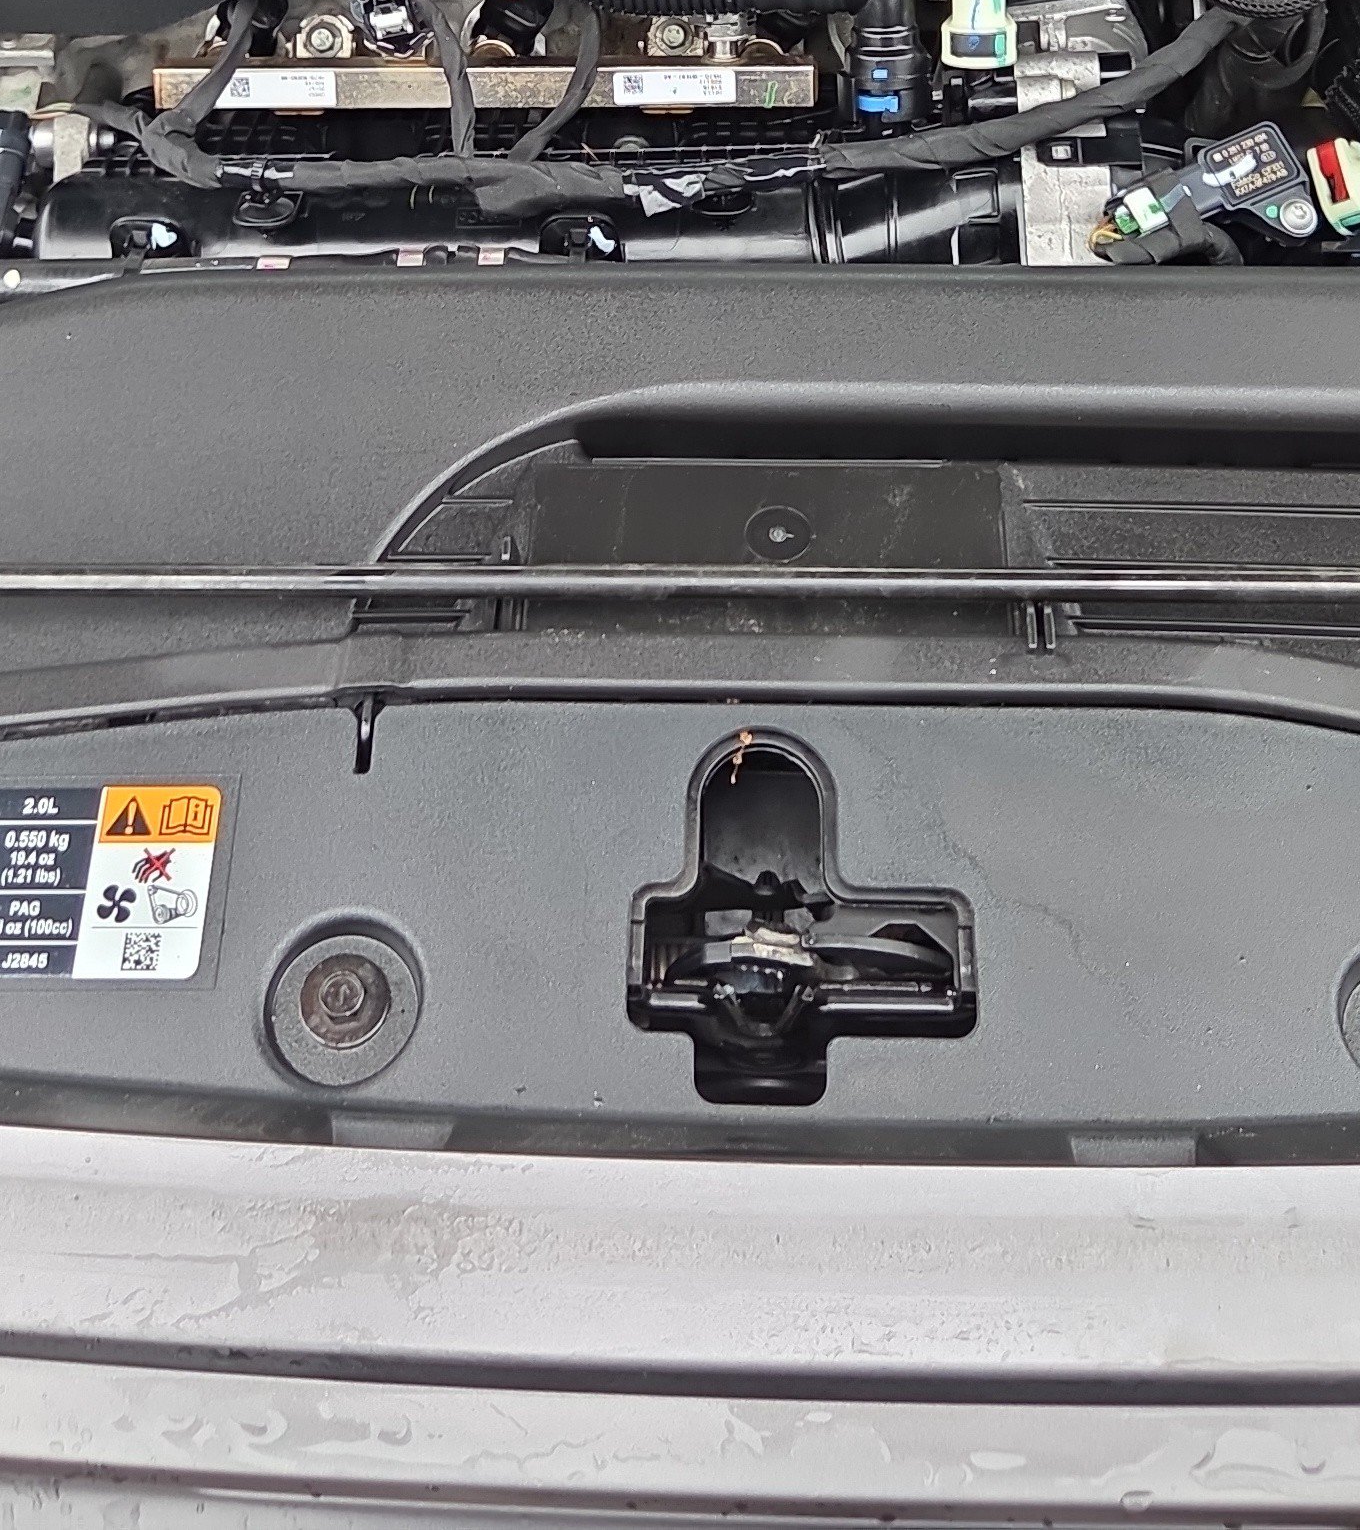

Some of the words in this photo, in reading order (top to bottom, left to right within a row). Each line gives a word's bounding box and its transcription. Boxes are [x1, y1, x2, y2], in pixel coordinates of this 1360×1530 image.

[22, 797, 59, 815] 2.0L
[4, 830, 47, 848] 0.550
[48, 831, 70, 852] kg
[9, 851, 37, 865] 19.4
[38, 852, 56, 865] oz
[0, 868, 33, 887] (1.21
[34, 868, 62, 887] lbs)
[8, 900, 42, 916] PAG
[5, 922, 23, 935] oz
[24, 918, 73, 938] (100cc)
[1, 952, 49, 969] J2845
